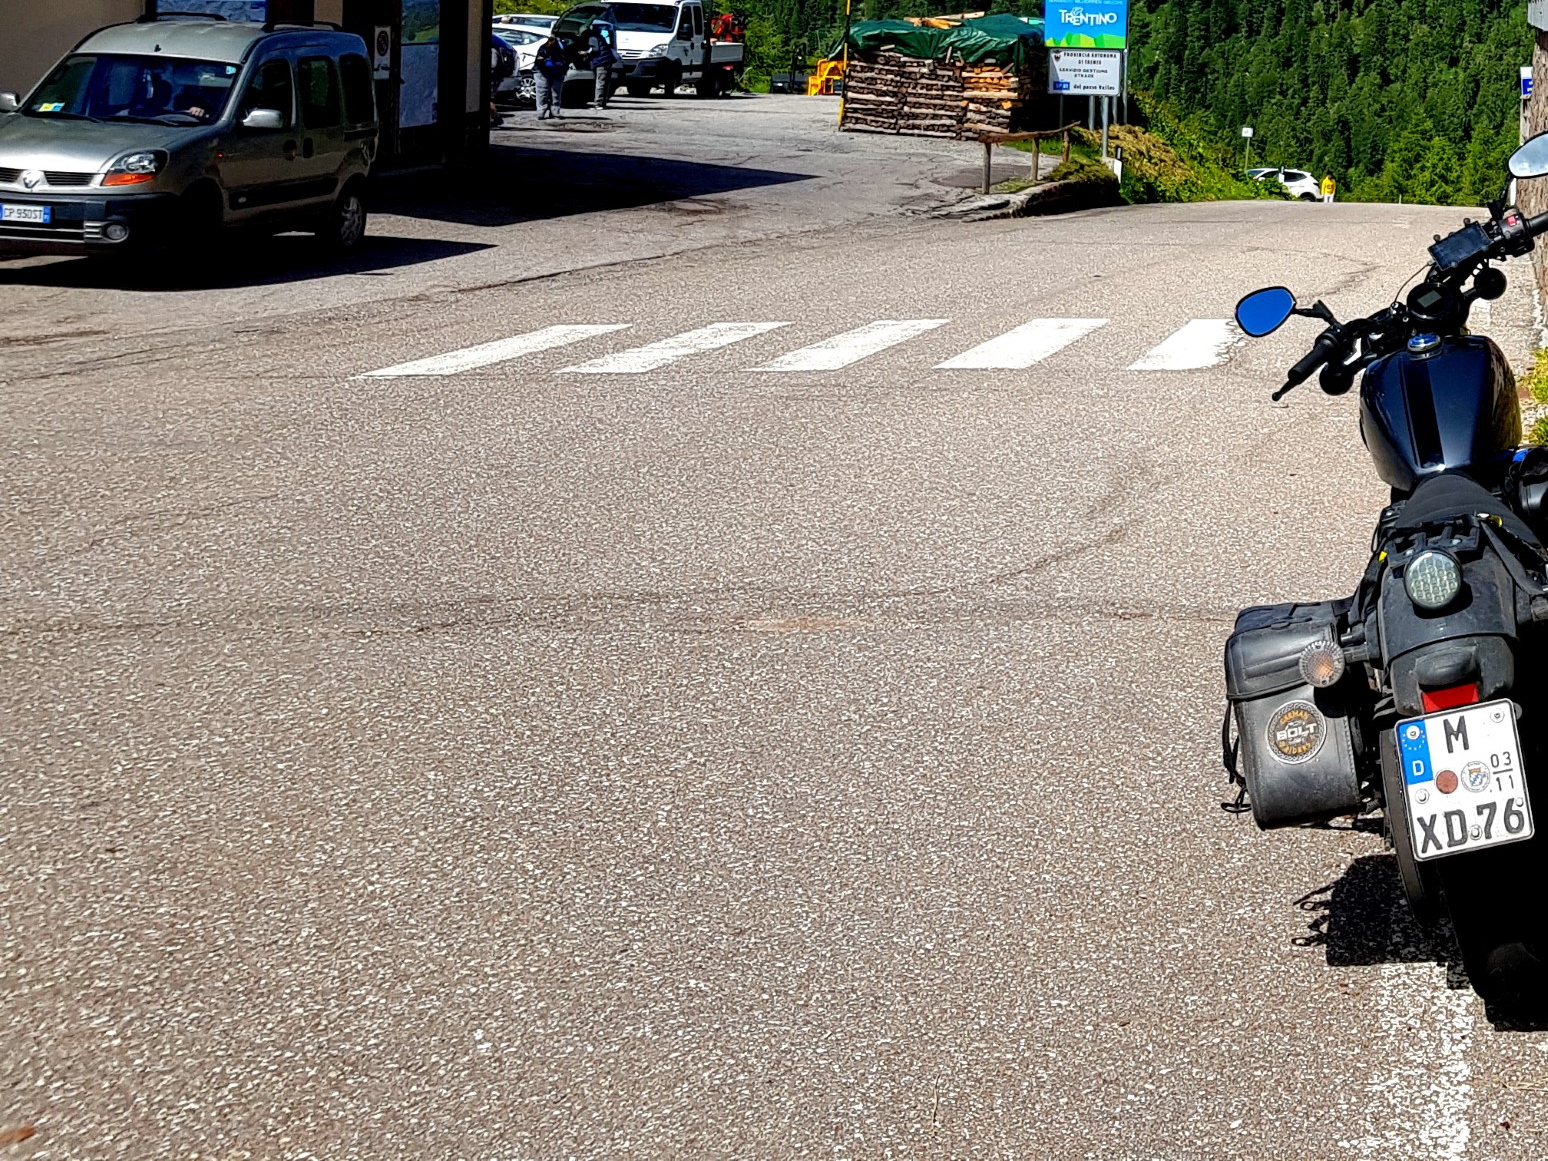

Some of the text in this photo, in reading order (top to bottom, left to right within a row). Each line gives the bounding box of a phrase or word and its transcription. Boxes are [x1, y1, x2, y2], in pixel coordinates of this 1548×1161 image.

[1059, 8, 1117, 26] TRENTINO
[1276, 723, 1317, 741] BOLT
[1443, 715, 1470, 754] M
[1412, 760, 1425, 776] D
[1490, 751, 1512, 768] 03
[1496, 774, 1514, 792] 11
[1416, 798, 1525, 854] XD 76
